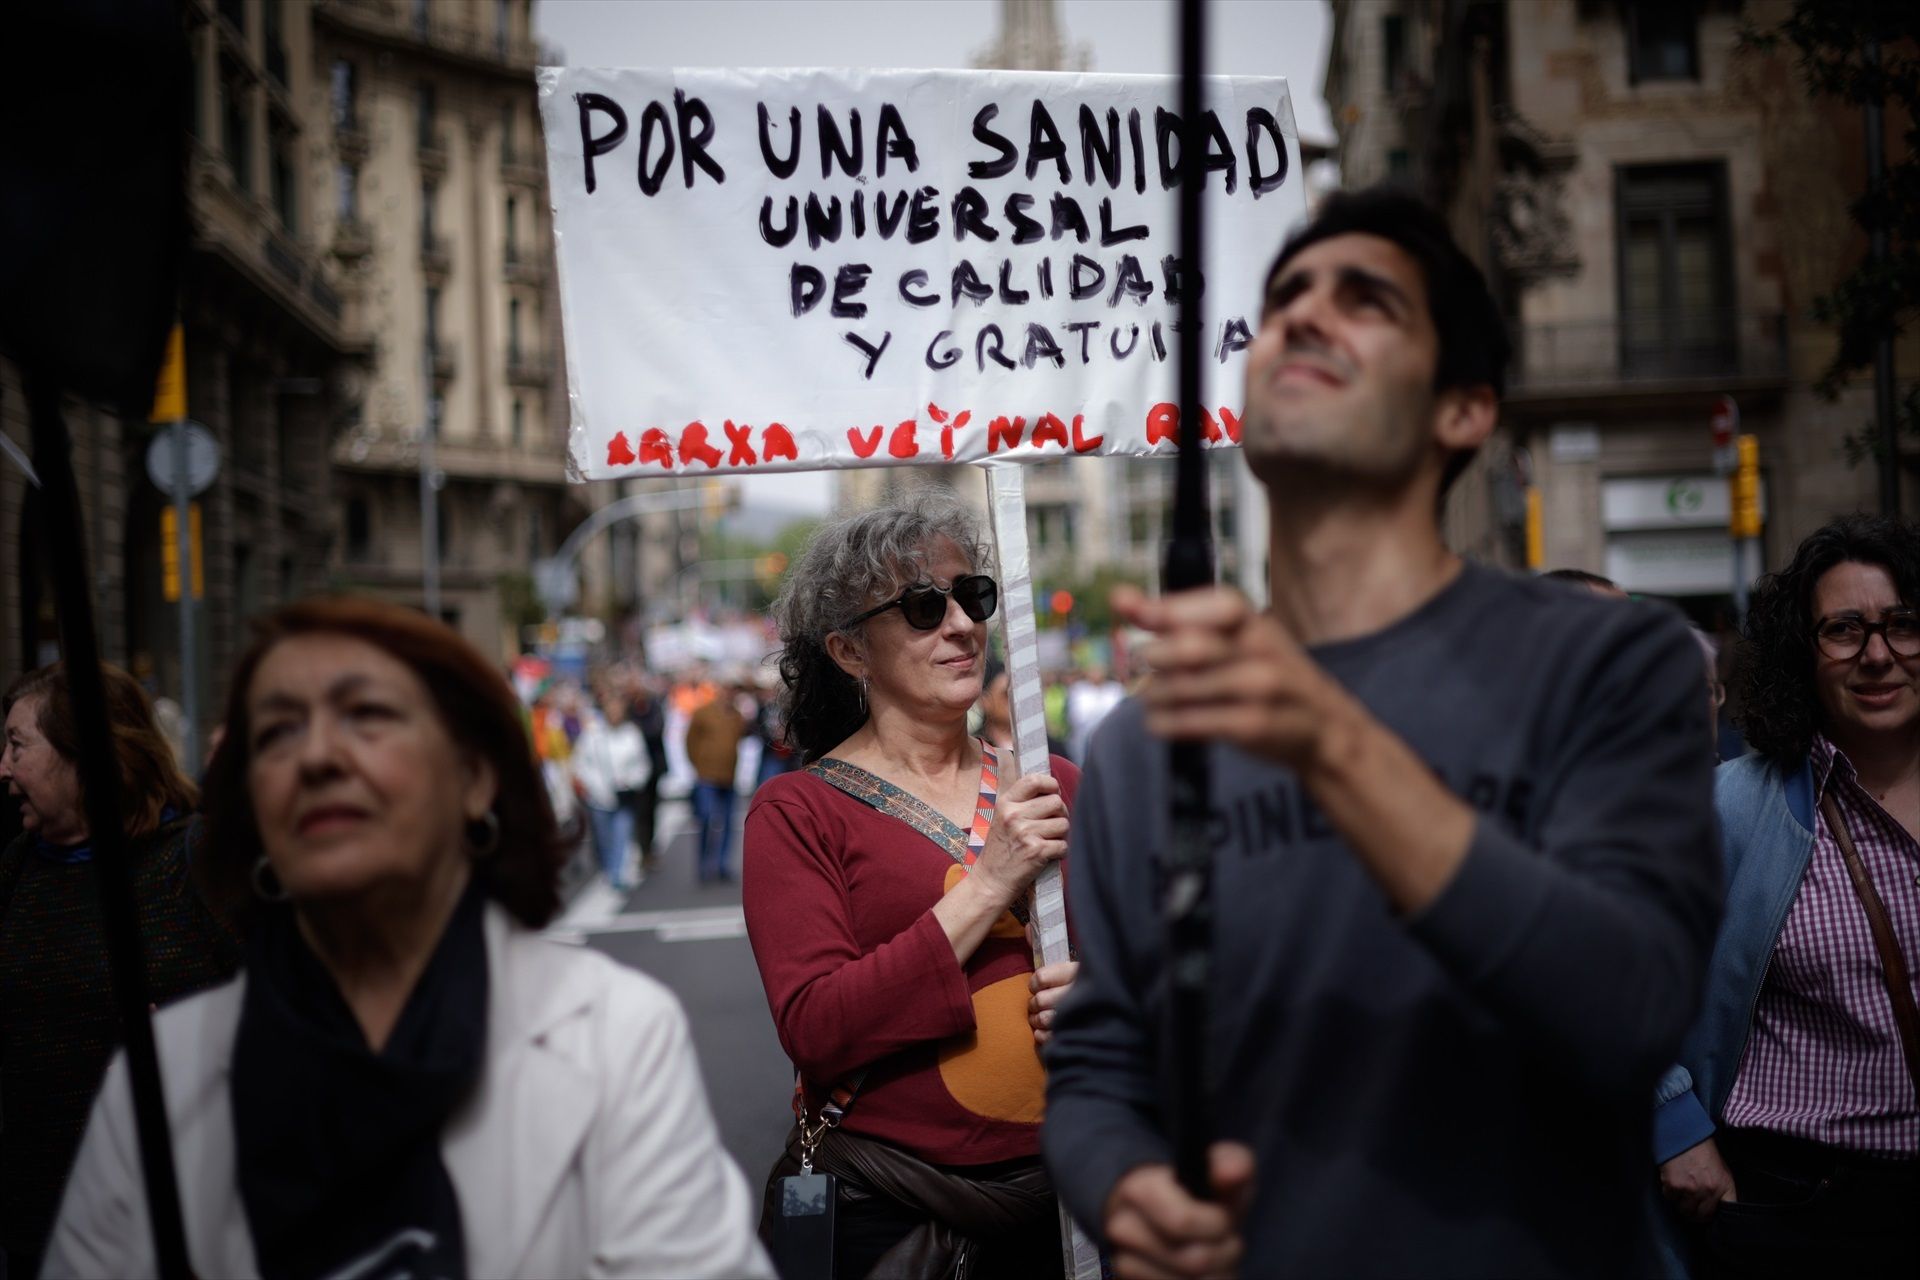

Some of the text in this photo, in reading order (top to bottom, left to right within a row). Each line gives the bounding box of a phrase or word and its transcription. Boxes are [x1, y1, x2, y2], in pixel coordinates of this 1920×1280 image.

[572, 87, 1289, 199] POR UNA SANIDAD
[759, 186, 1150, 251] UNIVERSAL
[790, 261, 873, 319] DE
[840, 330, 892, 380] Y
